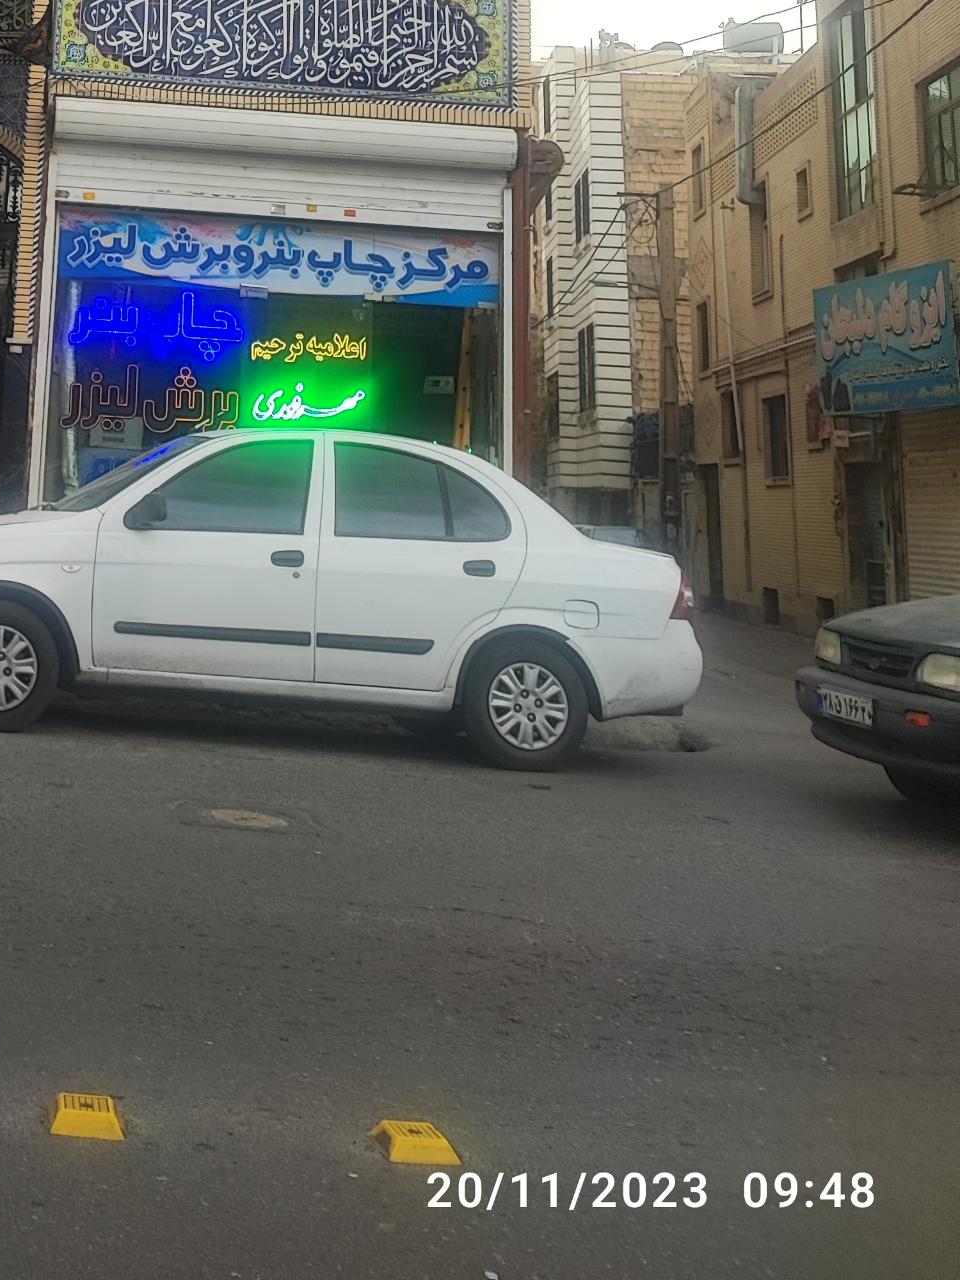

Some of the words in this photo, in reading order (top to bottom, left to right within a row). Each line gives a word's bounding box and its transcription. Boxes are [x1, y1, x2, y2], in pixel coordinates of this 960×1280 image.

[66, 222, 138, 268] لیزر
[142, 226, 232, 273] برش
[306, 239, 396, 292] چاپ
[395, 246, 491, 293] مرکز
[68, 298, 140, 346] بنر
[251, 332, 305, 363] ترحیم
[305, 332, 368, 362] اعلامیه
[60, 363, 140, 431] لیزر
[252, 382, 305, 421] فوری
